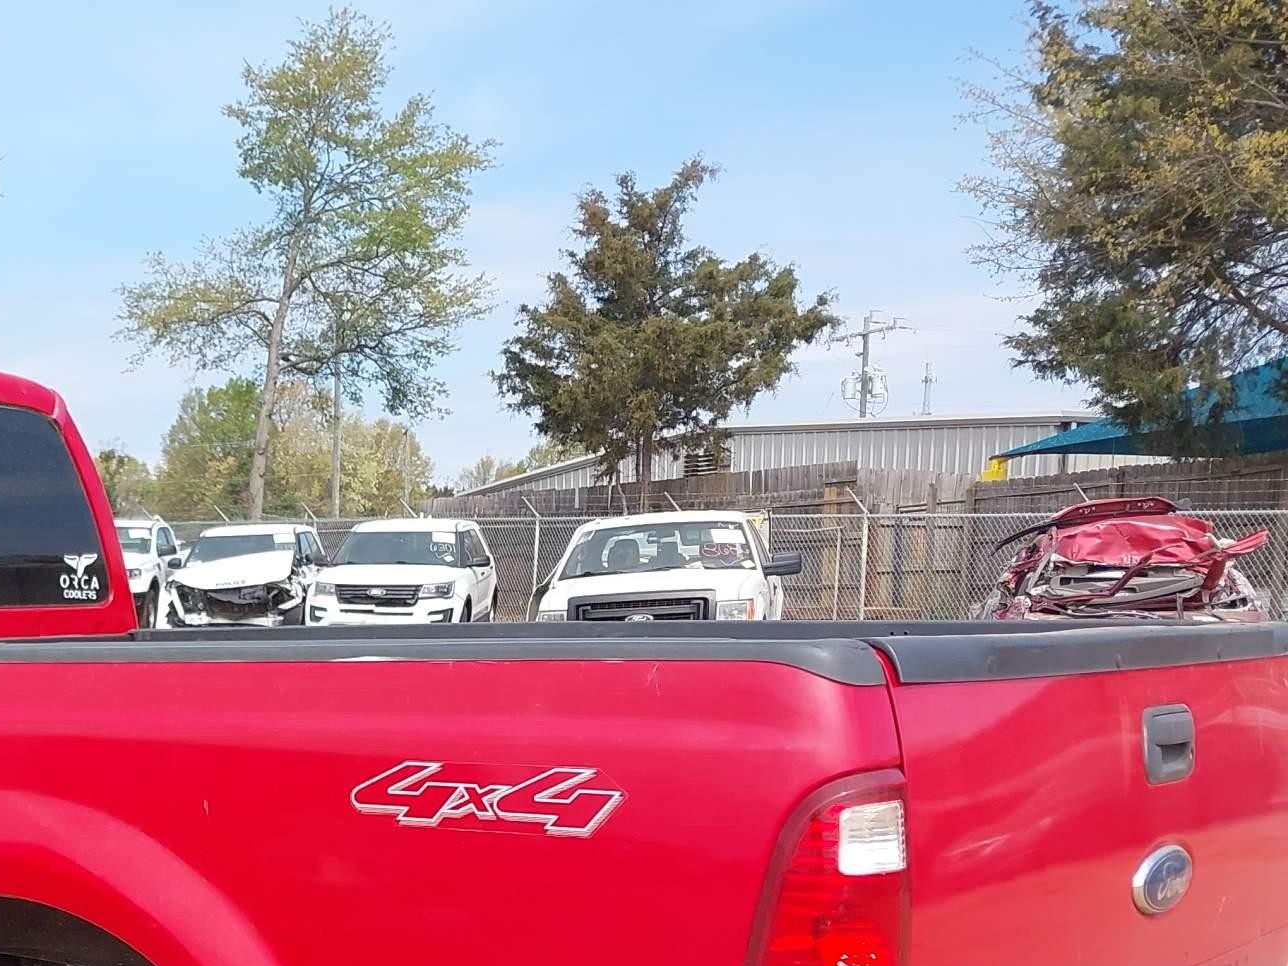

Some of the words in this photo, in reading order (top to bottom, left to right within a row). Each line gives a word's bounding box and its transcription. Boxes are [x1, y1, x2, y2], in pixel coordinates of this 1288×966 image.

[59, 574, 99, 590] ORCA
[63, 589, 97, 600] COOLERS
[350, 760, 623, 837] 4x4
